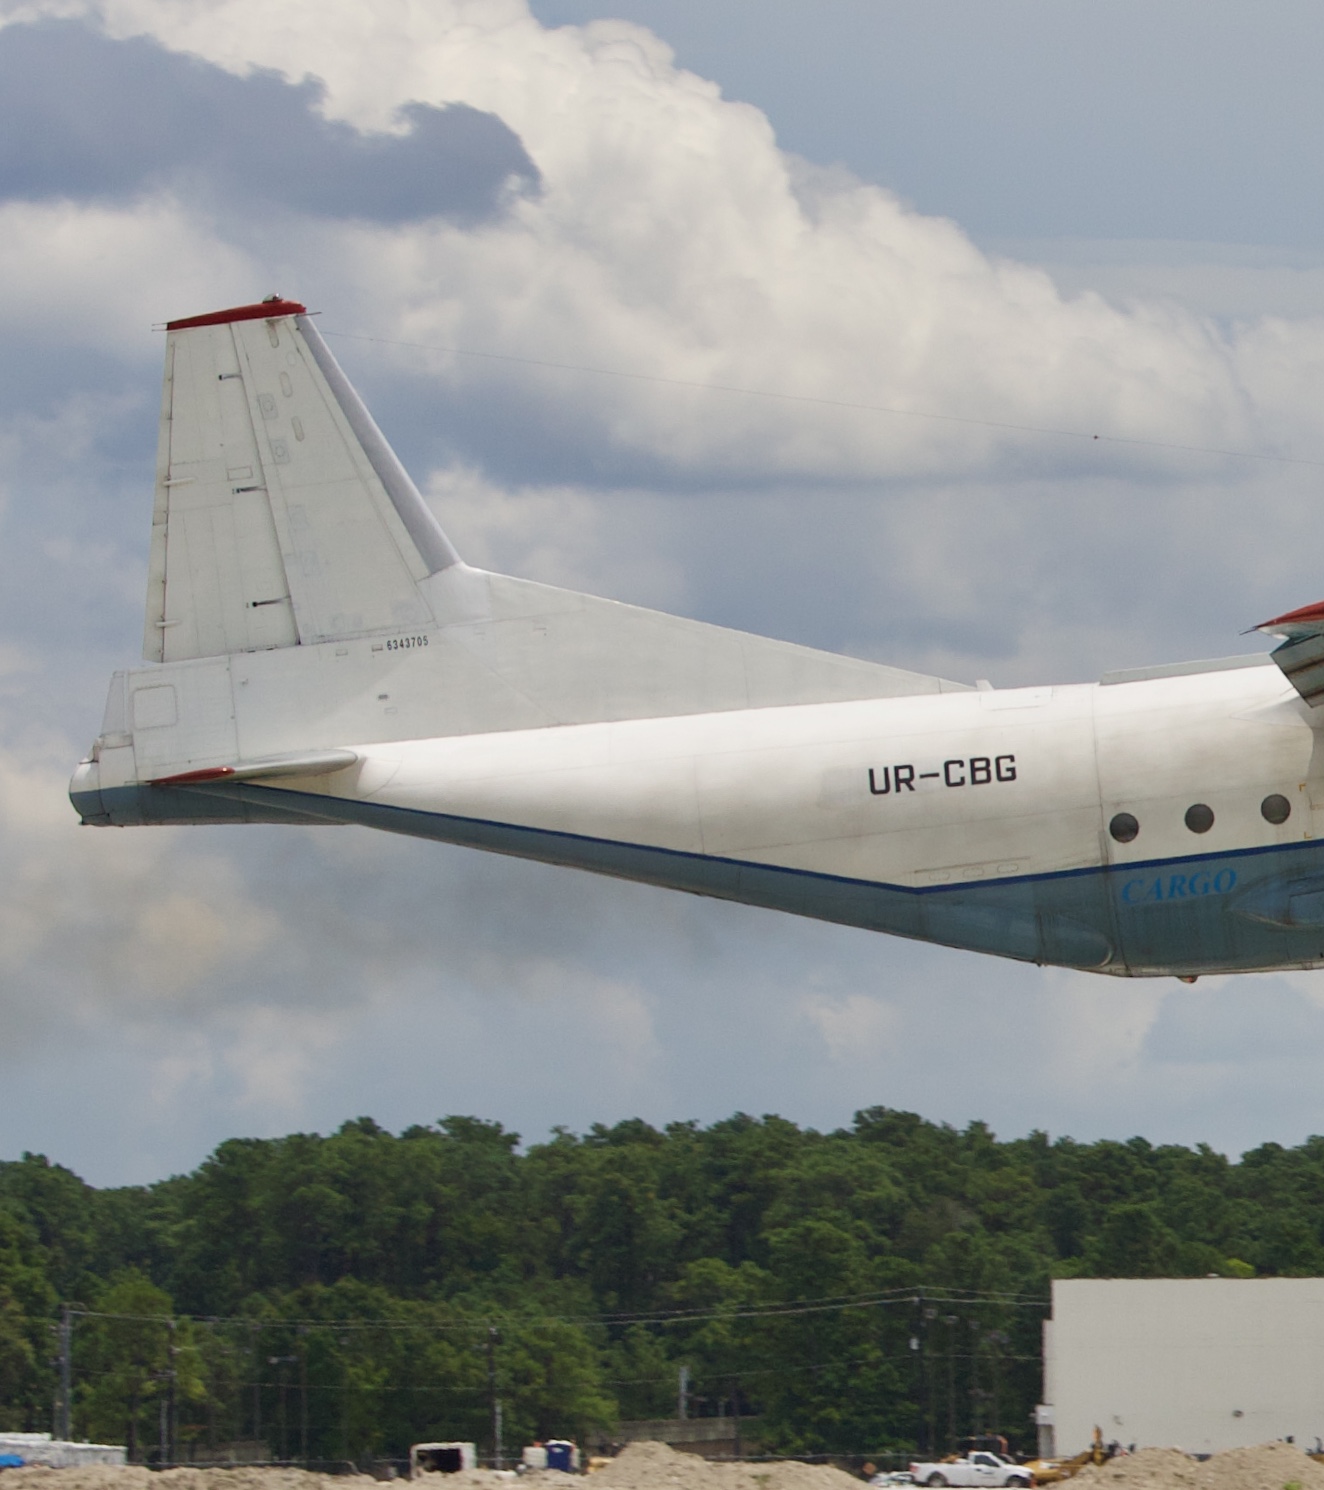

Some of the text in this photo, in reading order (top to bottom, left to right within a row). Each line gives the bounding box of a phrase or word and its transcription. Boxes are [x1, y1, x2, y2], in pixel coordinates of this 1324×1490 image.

[387, 635, 428, 650] 6343705
[868, 754, 1017, 795] UR-CBG
[1121, 867, 1237, 905] CARGO
